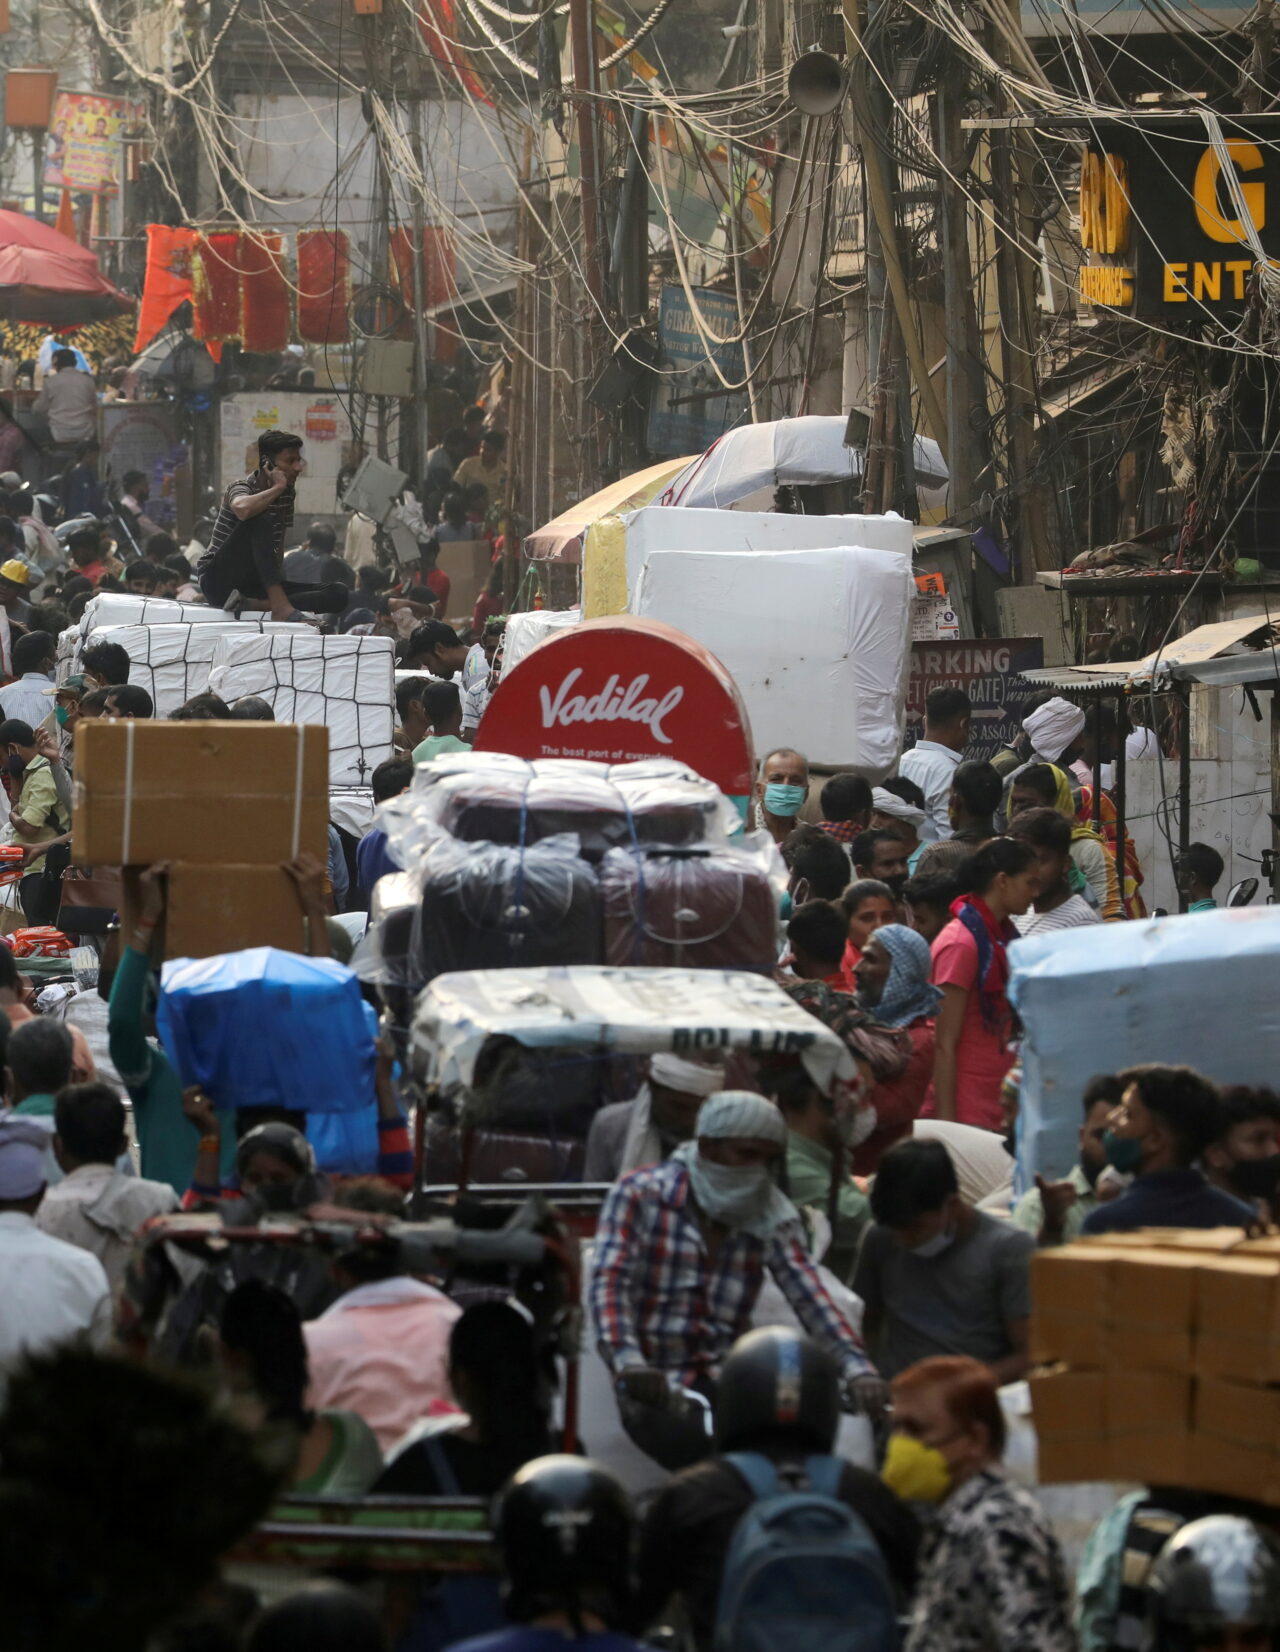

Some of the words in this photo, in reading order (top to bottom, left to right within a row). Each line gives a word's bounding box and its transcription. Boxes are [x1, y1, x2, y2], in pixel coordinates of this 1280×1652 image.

[1164, 259, 1280, 302] ENT
[910, 648, 1010, 675] ARKING
[539, 667, 684, 744] Vadilal
[541, 745, 559, 756] The
[562, 746, 585, 757] best
[587, 748, 609, 760] part
[611, 750, 624, 759] of
